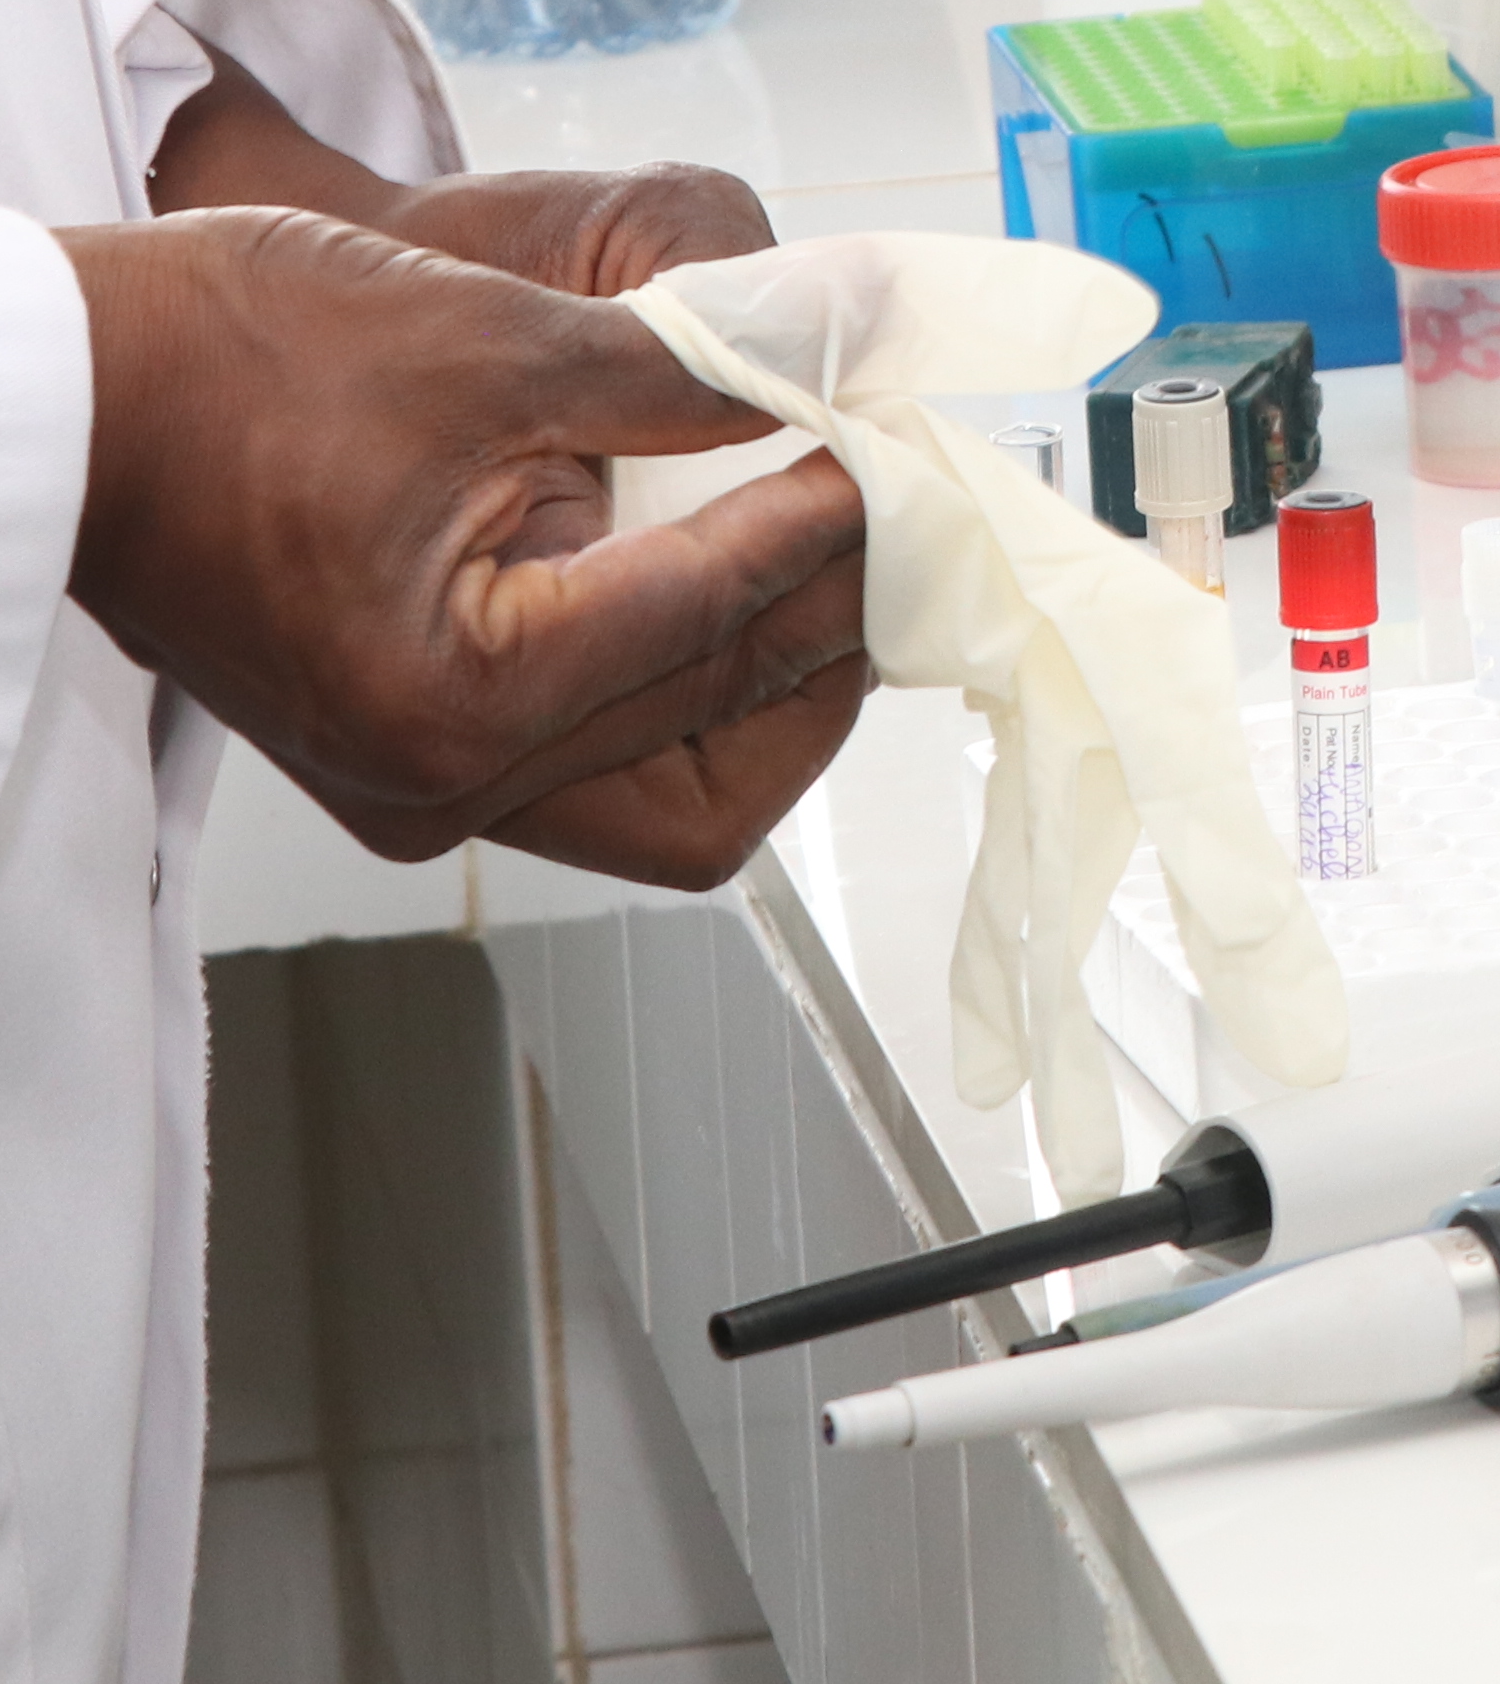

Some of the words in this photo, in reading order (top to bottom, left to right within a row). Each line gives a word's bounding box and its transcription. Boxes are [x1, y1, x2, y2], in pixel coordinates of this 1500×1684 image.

[1319, 649, 1352, 669] AB
[1302, 685, 1336, 701] Plain
[1340, 685, 1368, 700] Tube
[1301, 726, 1312, 768] Date:
